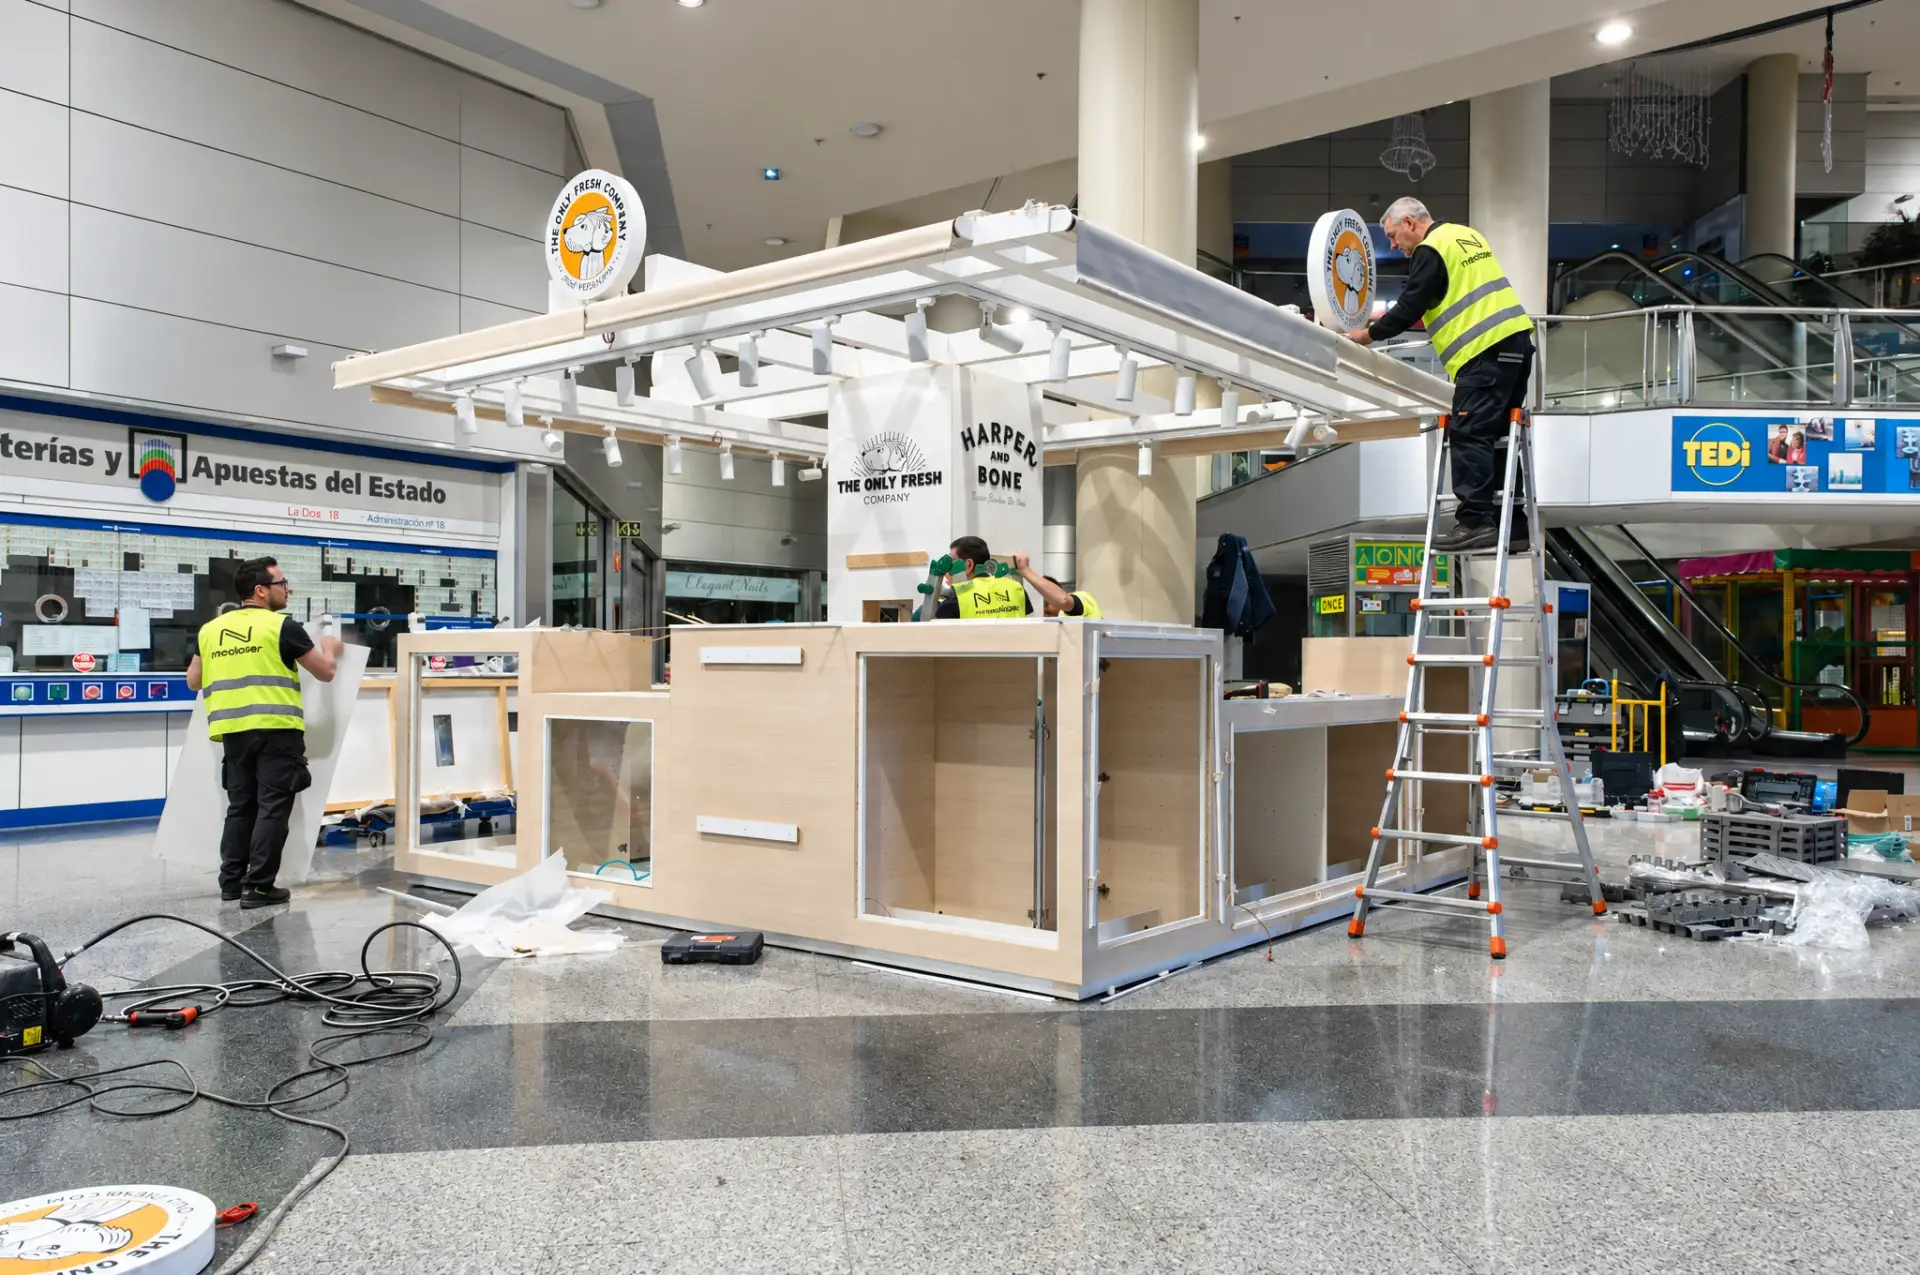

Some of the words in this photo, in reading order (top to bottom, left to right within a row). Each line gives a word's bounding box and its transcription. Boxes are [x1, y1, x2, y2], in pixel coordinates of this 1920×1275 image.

[551, 228, 560, 254] THE
[556, 193, 572, 225] ONLY
[574, 179, 602, 196] FRESH
[604, 183, 628, 241] COMPANY
[961, 422, 1038, 467] HARPER
[1683, 441, 1750, 467] TEDi
[0, 432, 94, 467] terías
[104, 450, 122, 476] y
[192, 455, 317, 490] Apuestas
[325, 471, 362, 495] del
[368, 475, 446, 504] Estado
[990, 450, 1010, 463] AND
[837, 479, 861, 494] THE
[864, 476, 896, 491] ONLY
[901, 471, 942, 488] FRESH
[978, 465, 1022, 490] BONE
[863, 492, 910, 505] COMPANY
[287, 506, 299, 517] La
[302, 508, 321, 519] Dos
[328, 510, 339, 520] 18
[367, 514, 424, 527] Administración
[437, 520, 445, 529] 18
[683, 573, 735, 596] Elegant
[737, 577, 769, 593] Nails
[1322, 598, 1343, 611] ONCE
[126, 1233, 183, 1259] THE
